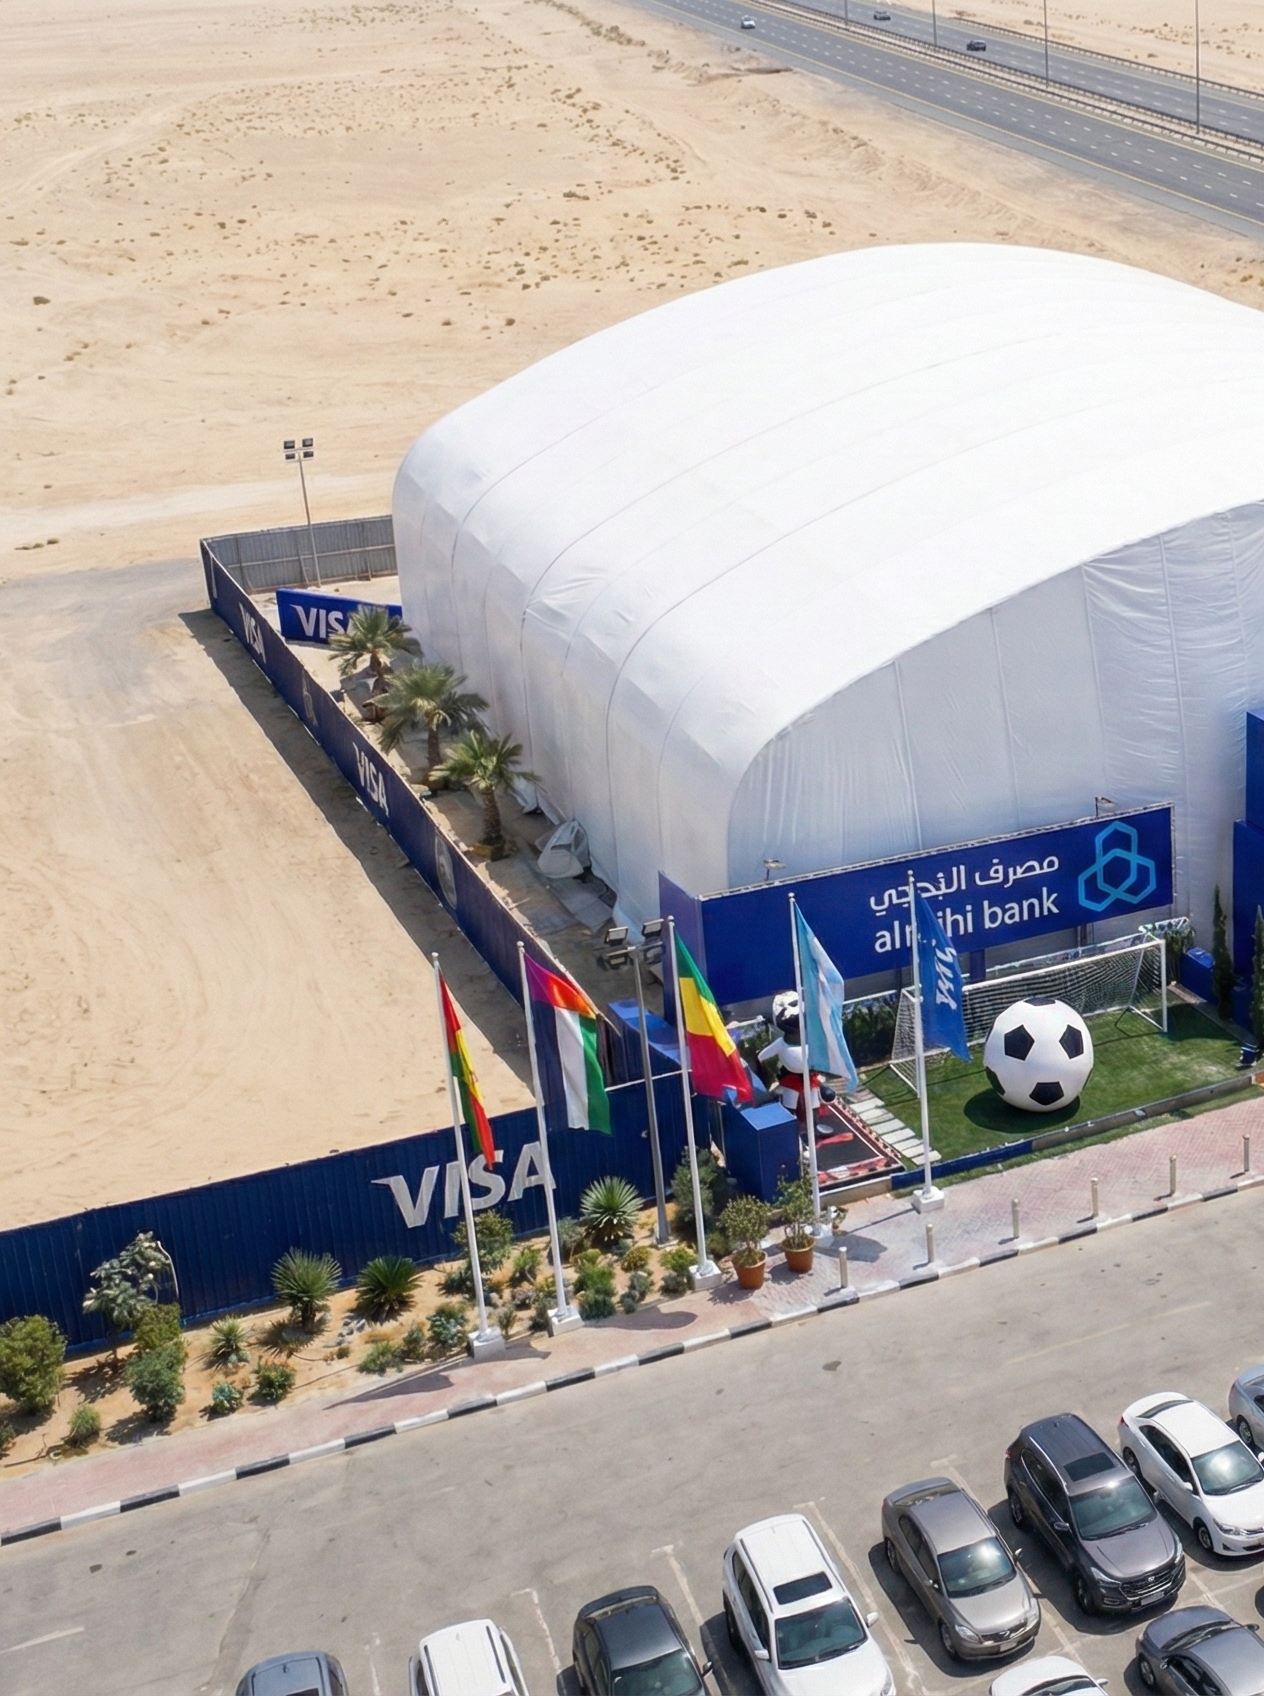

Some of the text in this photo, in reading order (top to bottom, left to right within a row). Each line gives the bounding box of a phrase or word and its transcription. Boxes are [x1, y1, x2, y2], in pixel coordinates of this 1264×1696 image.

[290, 604, 358, 639] VIS
[353, 742, 389, 818] VISA
[975, 855, 1060, 888] مصرف
[874, 887, 1060, 953] alrhi bank
[371, 1141, 556, 1228] VISA
